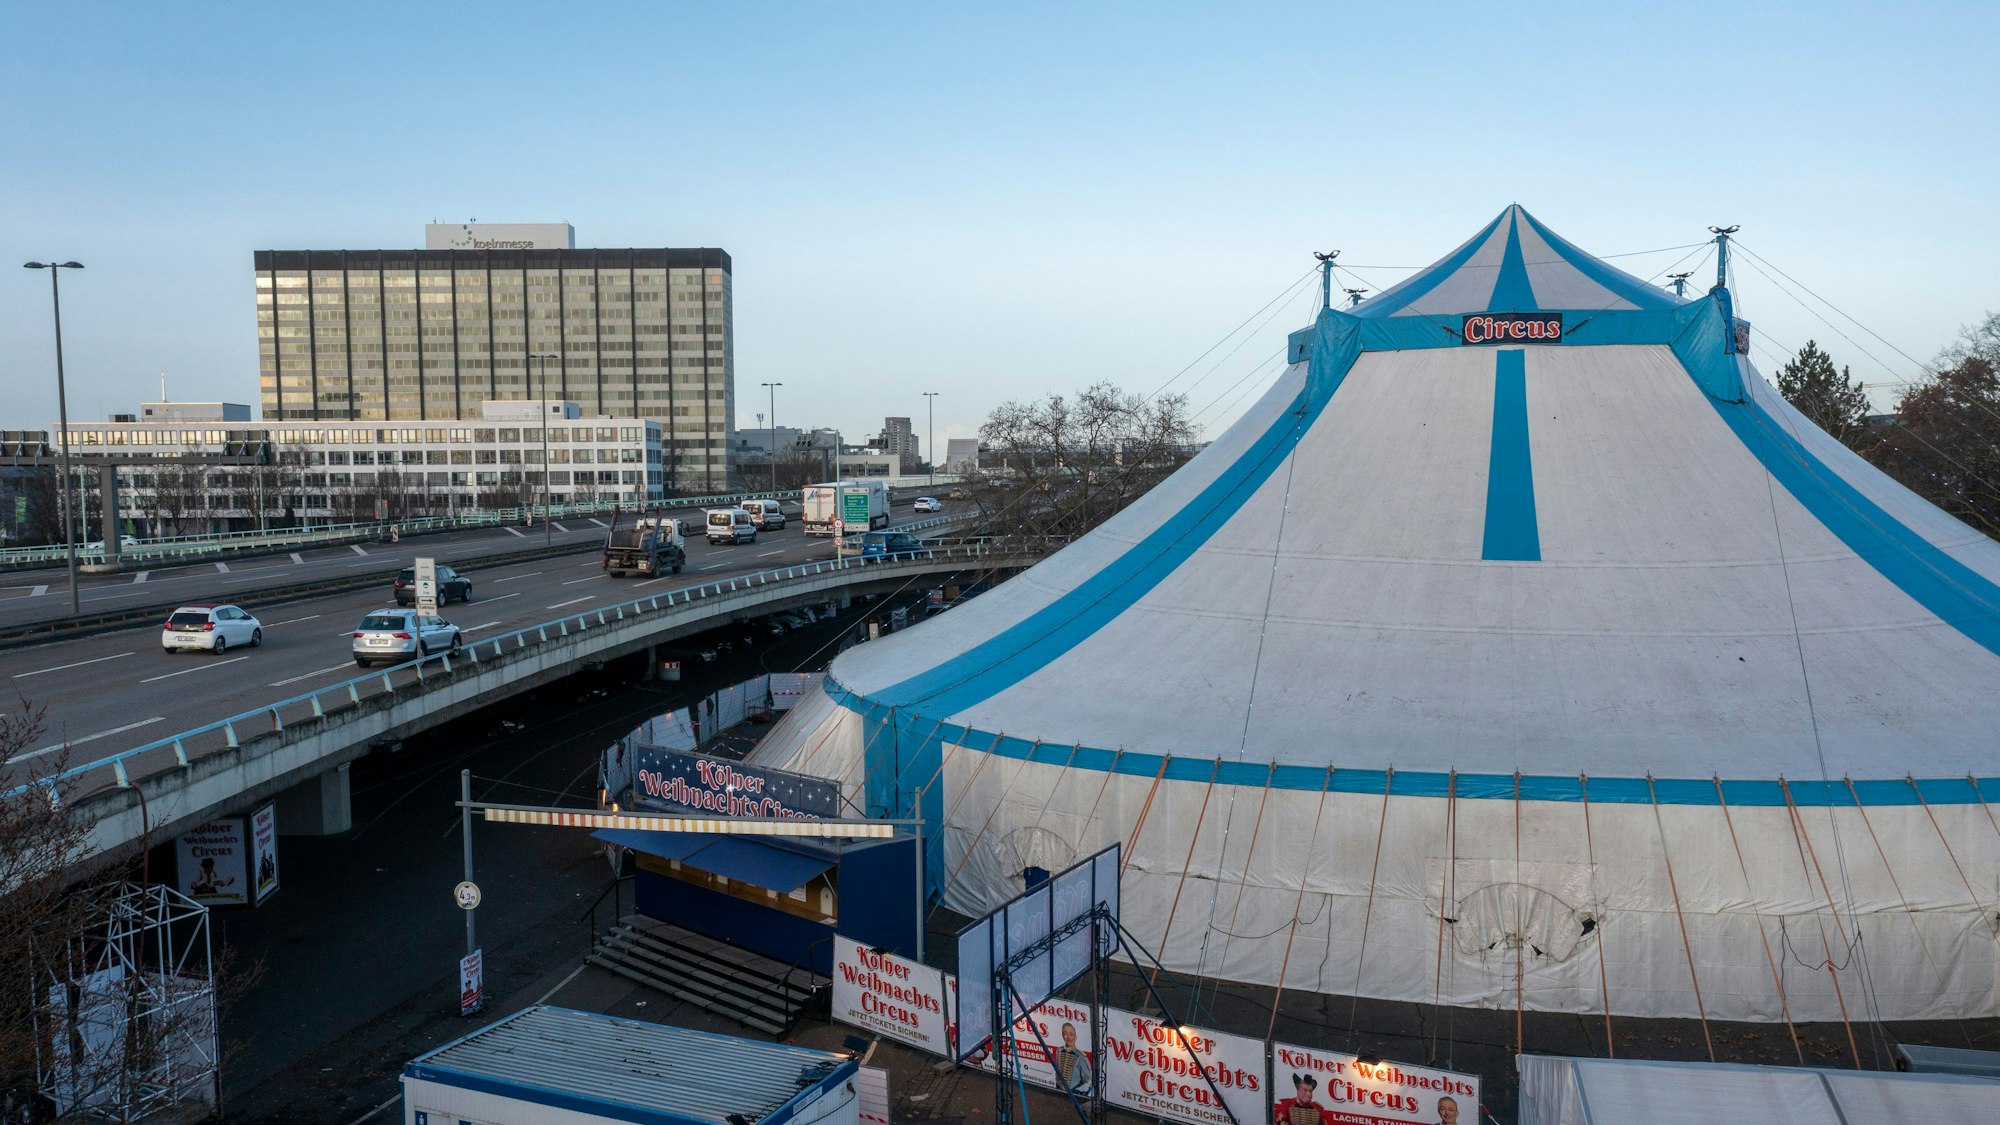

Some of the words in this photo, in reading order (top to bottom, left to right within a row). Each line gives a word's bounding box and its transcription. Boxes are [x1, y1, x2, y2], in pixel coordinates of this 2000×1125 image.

[473, 238, 534, 249] koelnmesse
[1464, 315, 1562, 343] Circus
[696, 760, 764, 793] Kölner
[191, 846, 234, 858] Circus
[856, 946, 911, 981] Kölner
[838, 961, 940, 1014] Weihnachts
[847, 1008, 868, 1023] JETZT
[868, 1015, 897, 1032] TICKETS
[897, 1025, 930, 1043] SICHERN!
[861, 991, 919, 1029] Circus
[1131, 1017, 1216, 1054] Kölner
[1107, 1036, 1260, 1091] Weihnachts
[1278, 1048, 1345, 1074] Kölner
[1352, 1061, 1474, 1097] Weihnachts
[1121, 1090, 1149, 1105] JETZT
[1151, 1098, 1191, 1115] TICKETS
[1139, 1070, 1224, 1110] Circus
[1327, 1078, 1419, 1114] Circus
[1332, 1113, 1375, 1125] LACHEN,
